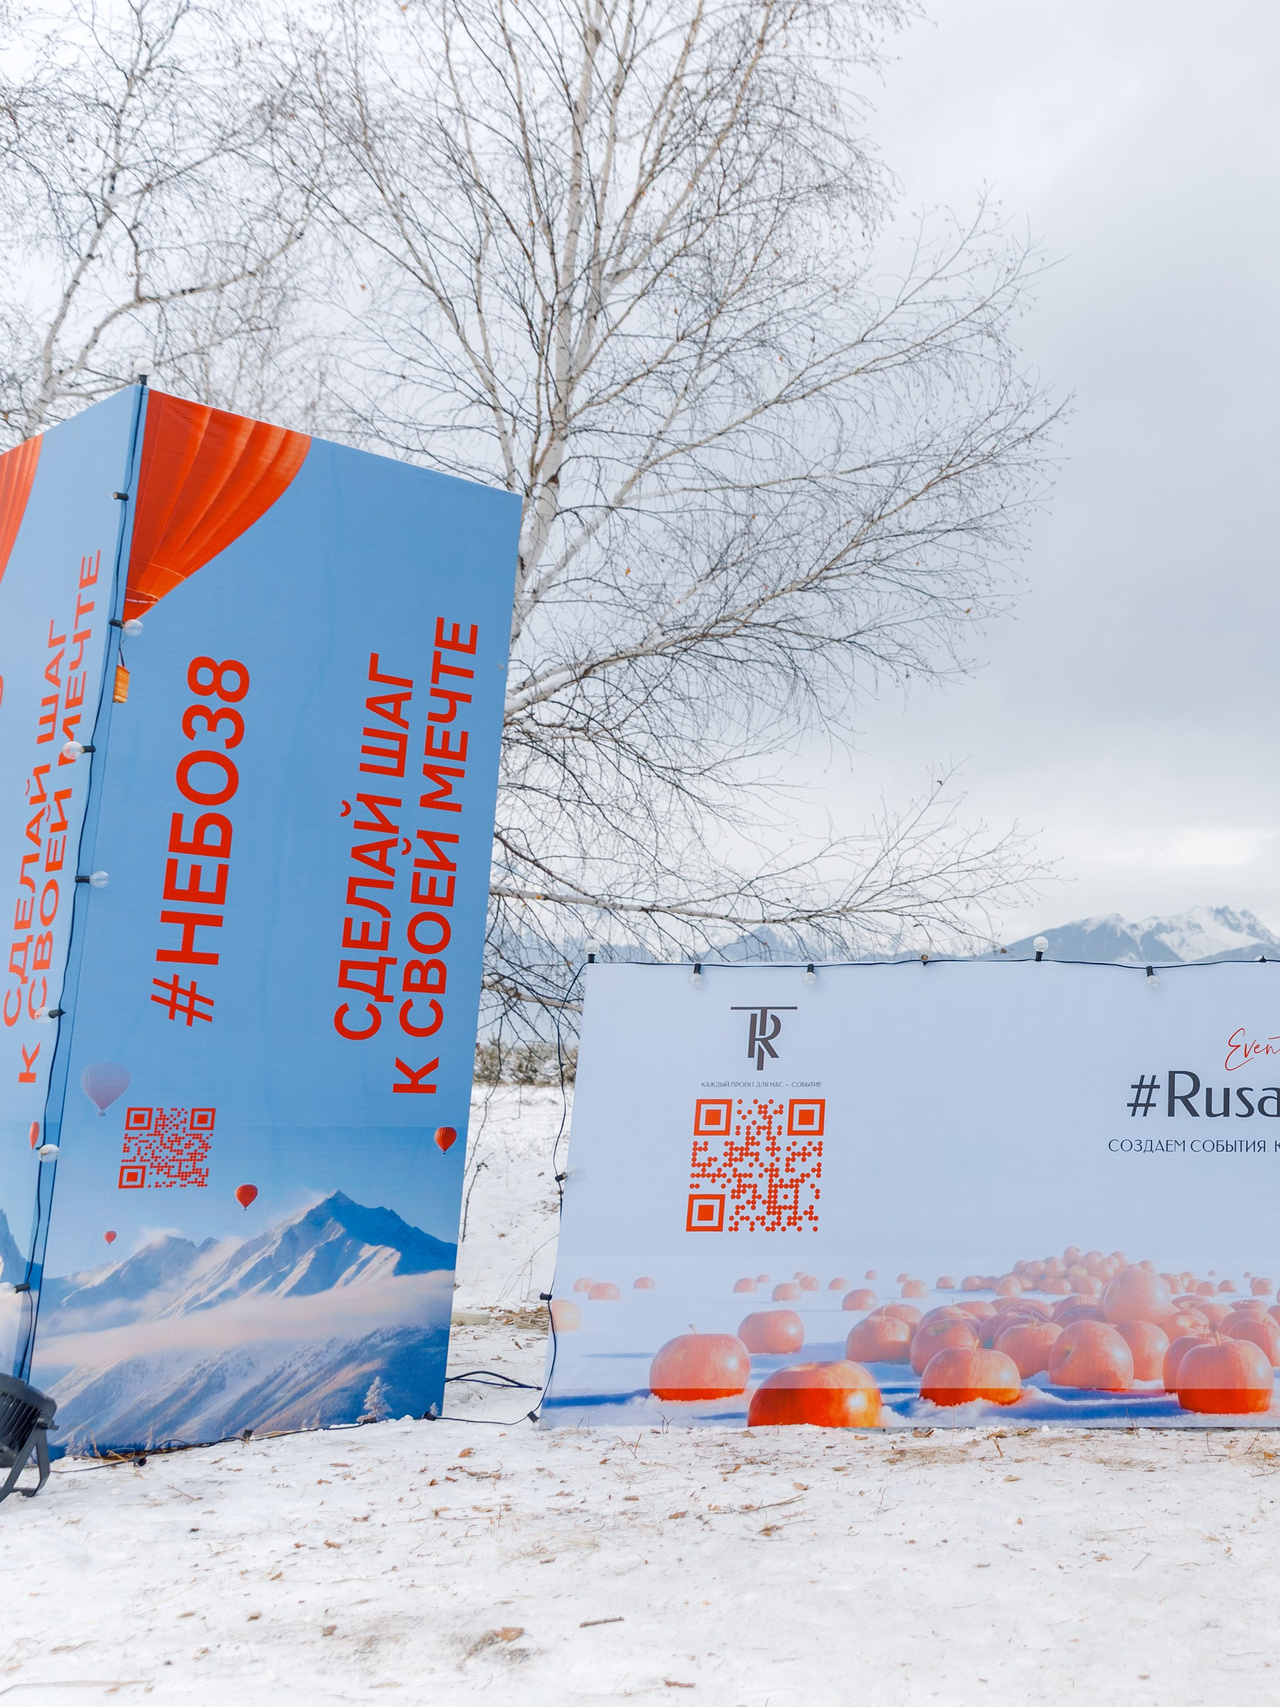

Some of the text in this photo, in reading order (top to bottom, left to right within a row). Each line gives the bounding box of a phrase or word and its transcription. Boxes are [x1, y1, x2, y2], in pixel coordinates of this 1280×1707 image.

[2, 618, 67, 1028] СДЕЛАЙ ШАГ
[18, 549, 102, 1084] К СВОЕЙ МЕЧТЕ
[150, 655, 250, 1027] #НЕБО38
[333, 652, 414, 1041] СДЕЛАЙ ШАГ
[392, 616, 479, 1094] К СВОЕЙ МЕЧТЕ
[700, 1080, 730, 1089] КАЖДЫЙ
[756, 1081, 769, 1089] ДЛЯ
[1108, 1138, 1186, 1154] СОЗДАЕМ
